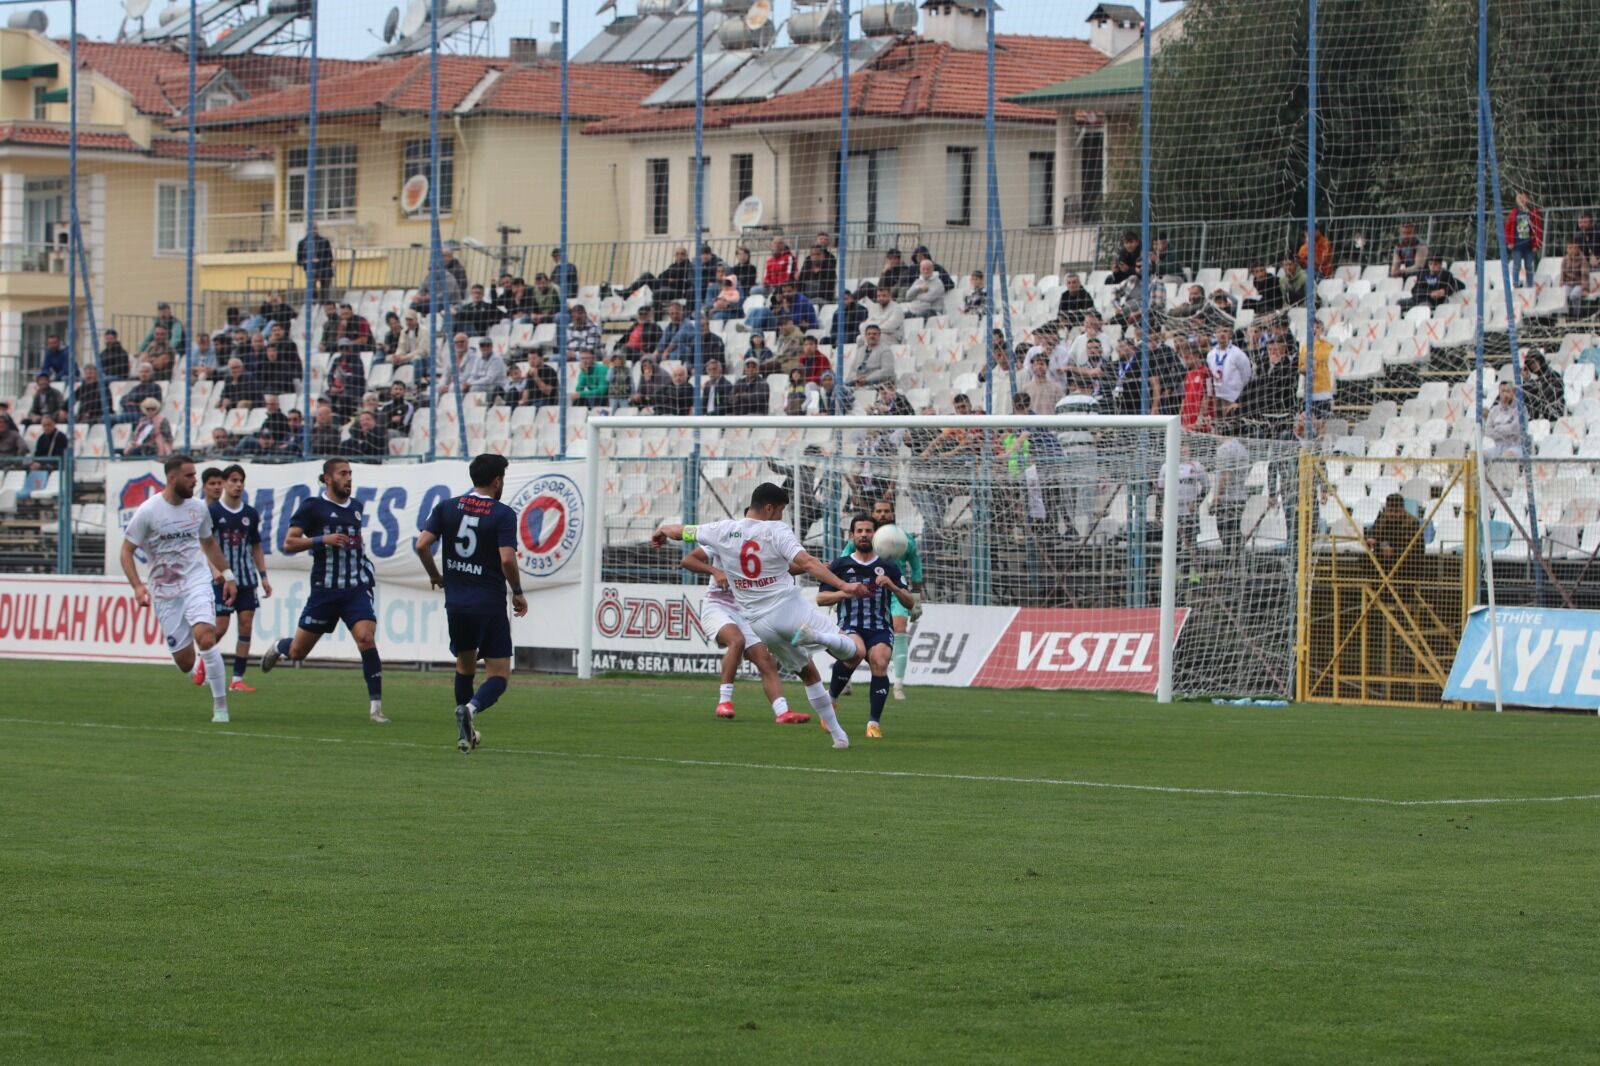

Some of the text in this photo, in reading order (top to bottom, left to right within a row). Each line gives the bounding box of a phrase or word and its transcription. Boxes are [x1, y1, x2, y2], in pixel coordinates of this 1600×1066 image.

[454, 514, 480, 558] 5
[525, 556, 553, 570] 1933
[740, 540, 762, 579] 6
[734, 578, 753, 589] EREN
[94, 596, 165, 645] KOYU
[621, 659, 634, 670] ve
[637, 656, 670, 672] SERA
[1016, 631, 1154, 672] VESTEL
